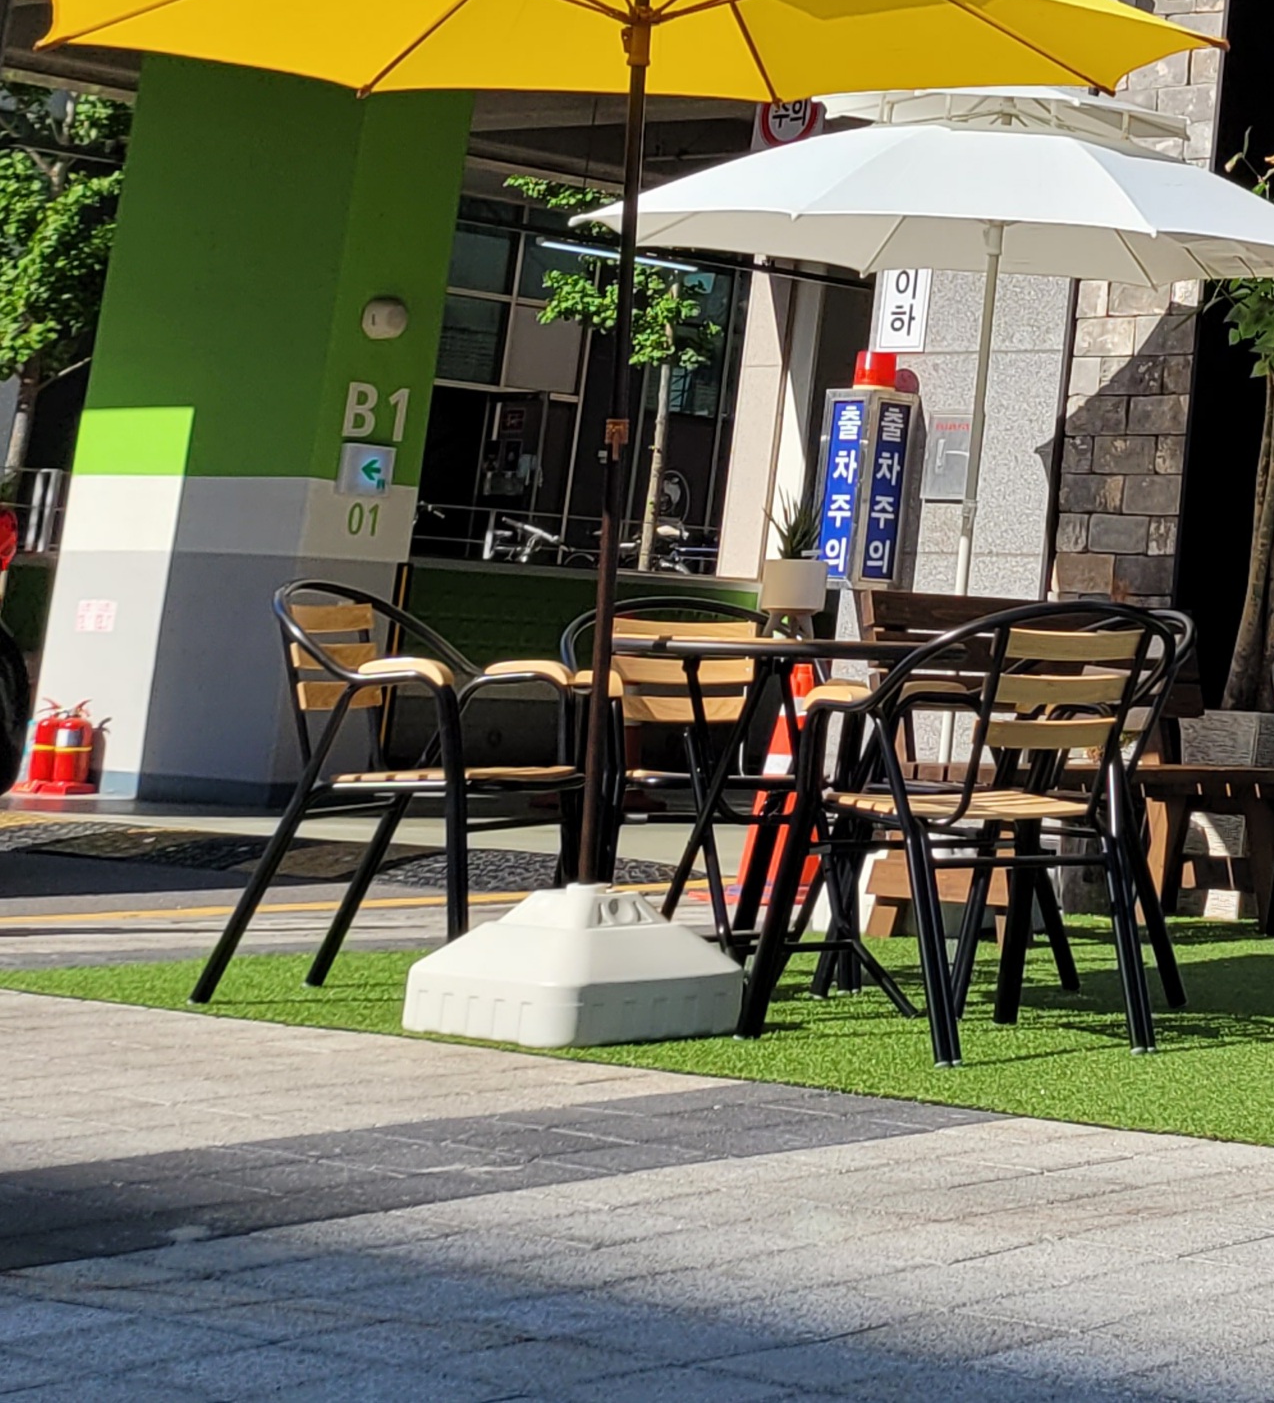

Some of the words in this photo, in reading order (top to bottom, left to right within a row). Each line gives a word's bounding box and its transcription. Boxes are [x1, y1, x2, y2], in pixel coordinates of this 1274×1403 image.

[341, 381, 411, 443] B1
[347, 502, 381, 537] 01
[824, 405, 862, 573] 출차주의
[866, 406, 905, 575] 출차주의
